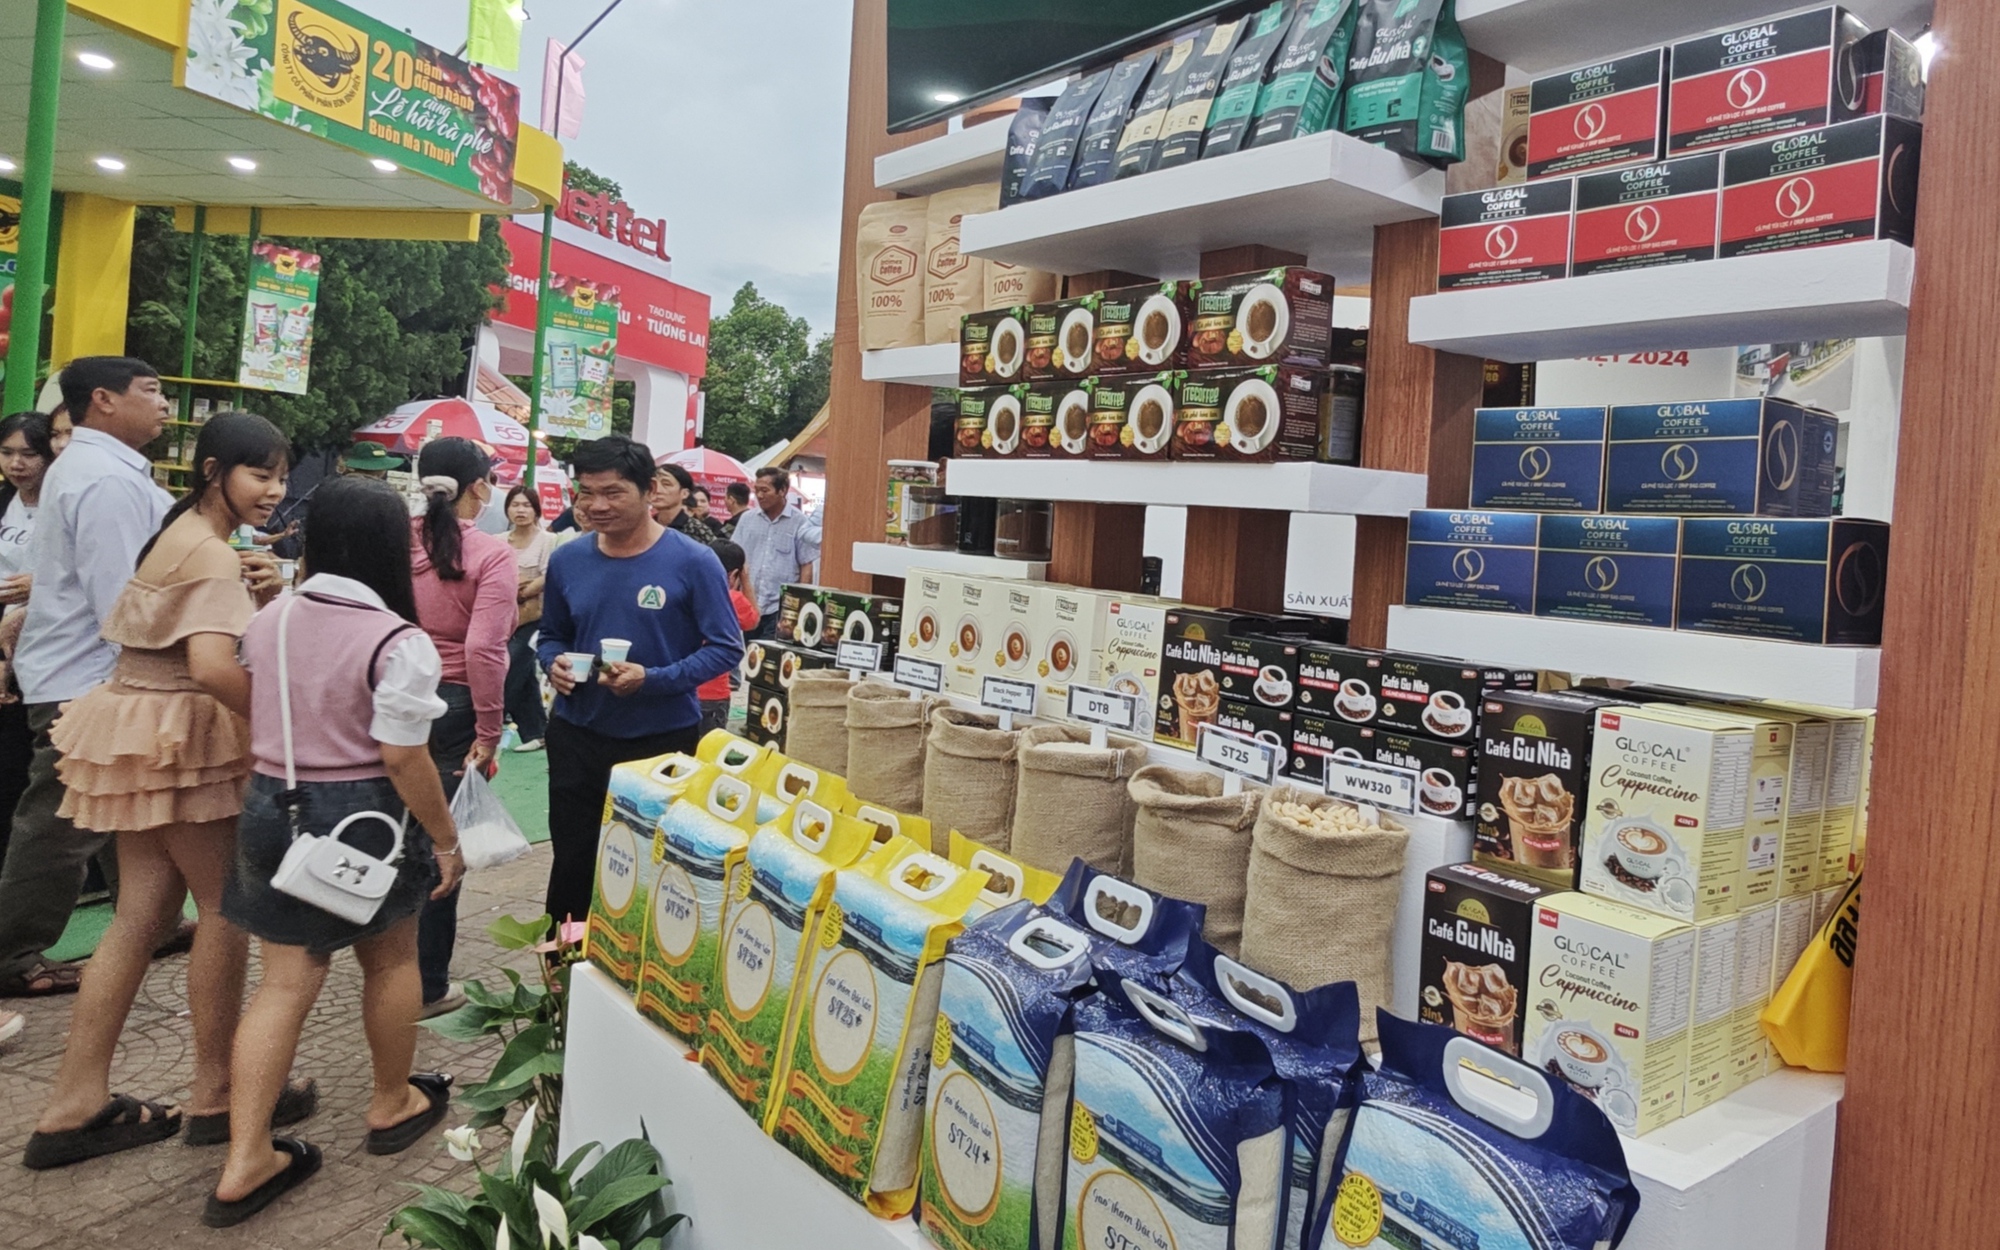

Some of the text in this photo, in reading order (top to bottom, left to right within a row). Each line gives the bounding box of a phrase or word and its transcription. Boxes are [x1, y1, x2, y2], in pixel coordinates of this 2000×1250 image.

[1720, 23, 1778, 47] GLOBAL
[1368, 46, 1387, 67] Gu
[1384, 40, 1412, 64] Nhà
[1728, 38, 1770, 54] COFFEE
[372, 40, 414, 90] 20
[415, 58, 442, 81] năm
[1570, 63, 1616, 84] GLOBAL
[1576, 76, 1610, 91] COFFEE
[414, 73, 474, 112] đồng hành
[422, 96, 452, 124] cùng
[368, 87, 494, 158] Lễ hội cà phê
[368, 118, 454, 166] Buôn Ma Thuột
[1771, 132, 1828, 154] GLOBAL
[1778, 146, 1818, 162] COFFEE
[1620, 164, 1671, 182] GLOBAL
[1626, 178, 1663, 191] COFFEE
[1482, 188, 1528, 204] GLOBAL
[1486, 200, 1520, 212] COFFEE
[880, 265, 902, 274] Coffee
[994, 278, 1023, 295] 100%
[871, 295, 902, 308] 100%
[928, 288, 954, 304] 100%
[648, 304, 664, 318] TẠO
[646, 318, 706, 348] TƯƠNG LAI
[1628, 350, 1689, 367] 2024
[1516, 410, 1561, 421] GLOBAL
[1657, 404, 1710, 416] GLOBAL
[1520, 422, 1554, 430] COFFEE
[1662, 418, 1702, 427] COFFEE
[494, 425, 526, 442] 5G
[1450, 514, 1494, 526] GLOBAL
[1581, 518, 1630, 530] GLOBAL
[1726, 522, 1778, 535] GLOBAL
[1454, 526, 1488, 534] COFFEE
[1586, 532, 1622, 540] COFFEE
[1732, 536, 1770, 546] COFFEE
[1286, 592, 1352, 608] SẢN XUẤ
[1116, 618, 1152, 632] GLOCAL
[1120, 630, 1147, 640] COFFEE
[1108, 638, 1158, 660] Cappuccino
[1166, 641, 1221, 666] Café Gu Nhà
[1222, 651, 1260, 668] Café Gu Nhà
[1300, 664, 1340, 682] Café Gu Nhà
[1382, 674, 1430, 694] Café Gu Nhà
[1006, 689, 1022, 697] Pepper
[1088, 701, 1109, 714] DT8
[1218, 714, 1255, 733] Café Gu Nhà
[1602, 717, 1619, 726] NEW
[1294, 730, 1334, 750] Café Gu Nhà
[1221, 745, 1249, 764] ST25
[1486, 736, 1572, 770] Café Gu Nhà
[1615, 736, 1686, 762] GLOCAL
[1376, 748, 1422, 770] Café Gu Nhà
[1622, 754, 1676, 772] COFFEE
[1600, 764, 1700, 802] Cappuccino
[1626, 769, 1672, 784] Coconut Coffee
[1345, 775, 1392, 796] WW320
[1449, 865, 1542, 894] Café Gu Nhà
[1540, 913, 1557, 923] NEW
[1428, 918, 1516, 962] Café Gu Nhà
[1554, 936, 1626, 969] GLOCAL
[1561, 954, 1616, 978] COFFEE
[1540, 964, 1640, 1012] Cappuccino
[1565, 970, 1612, 991] Coconut Coffee
[1451, 1226, 1471, 1244] FOOD
